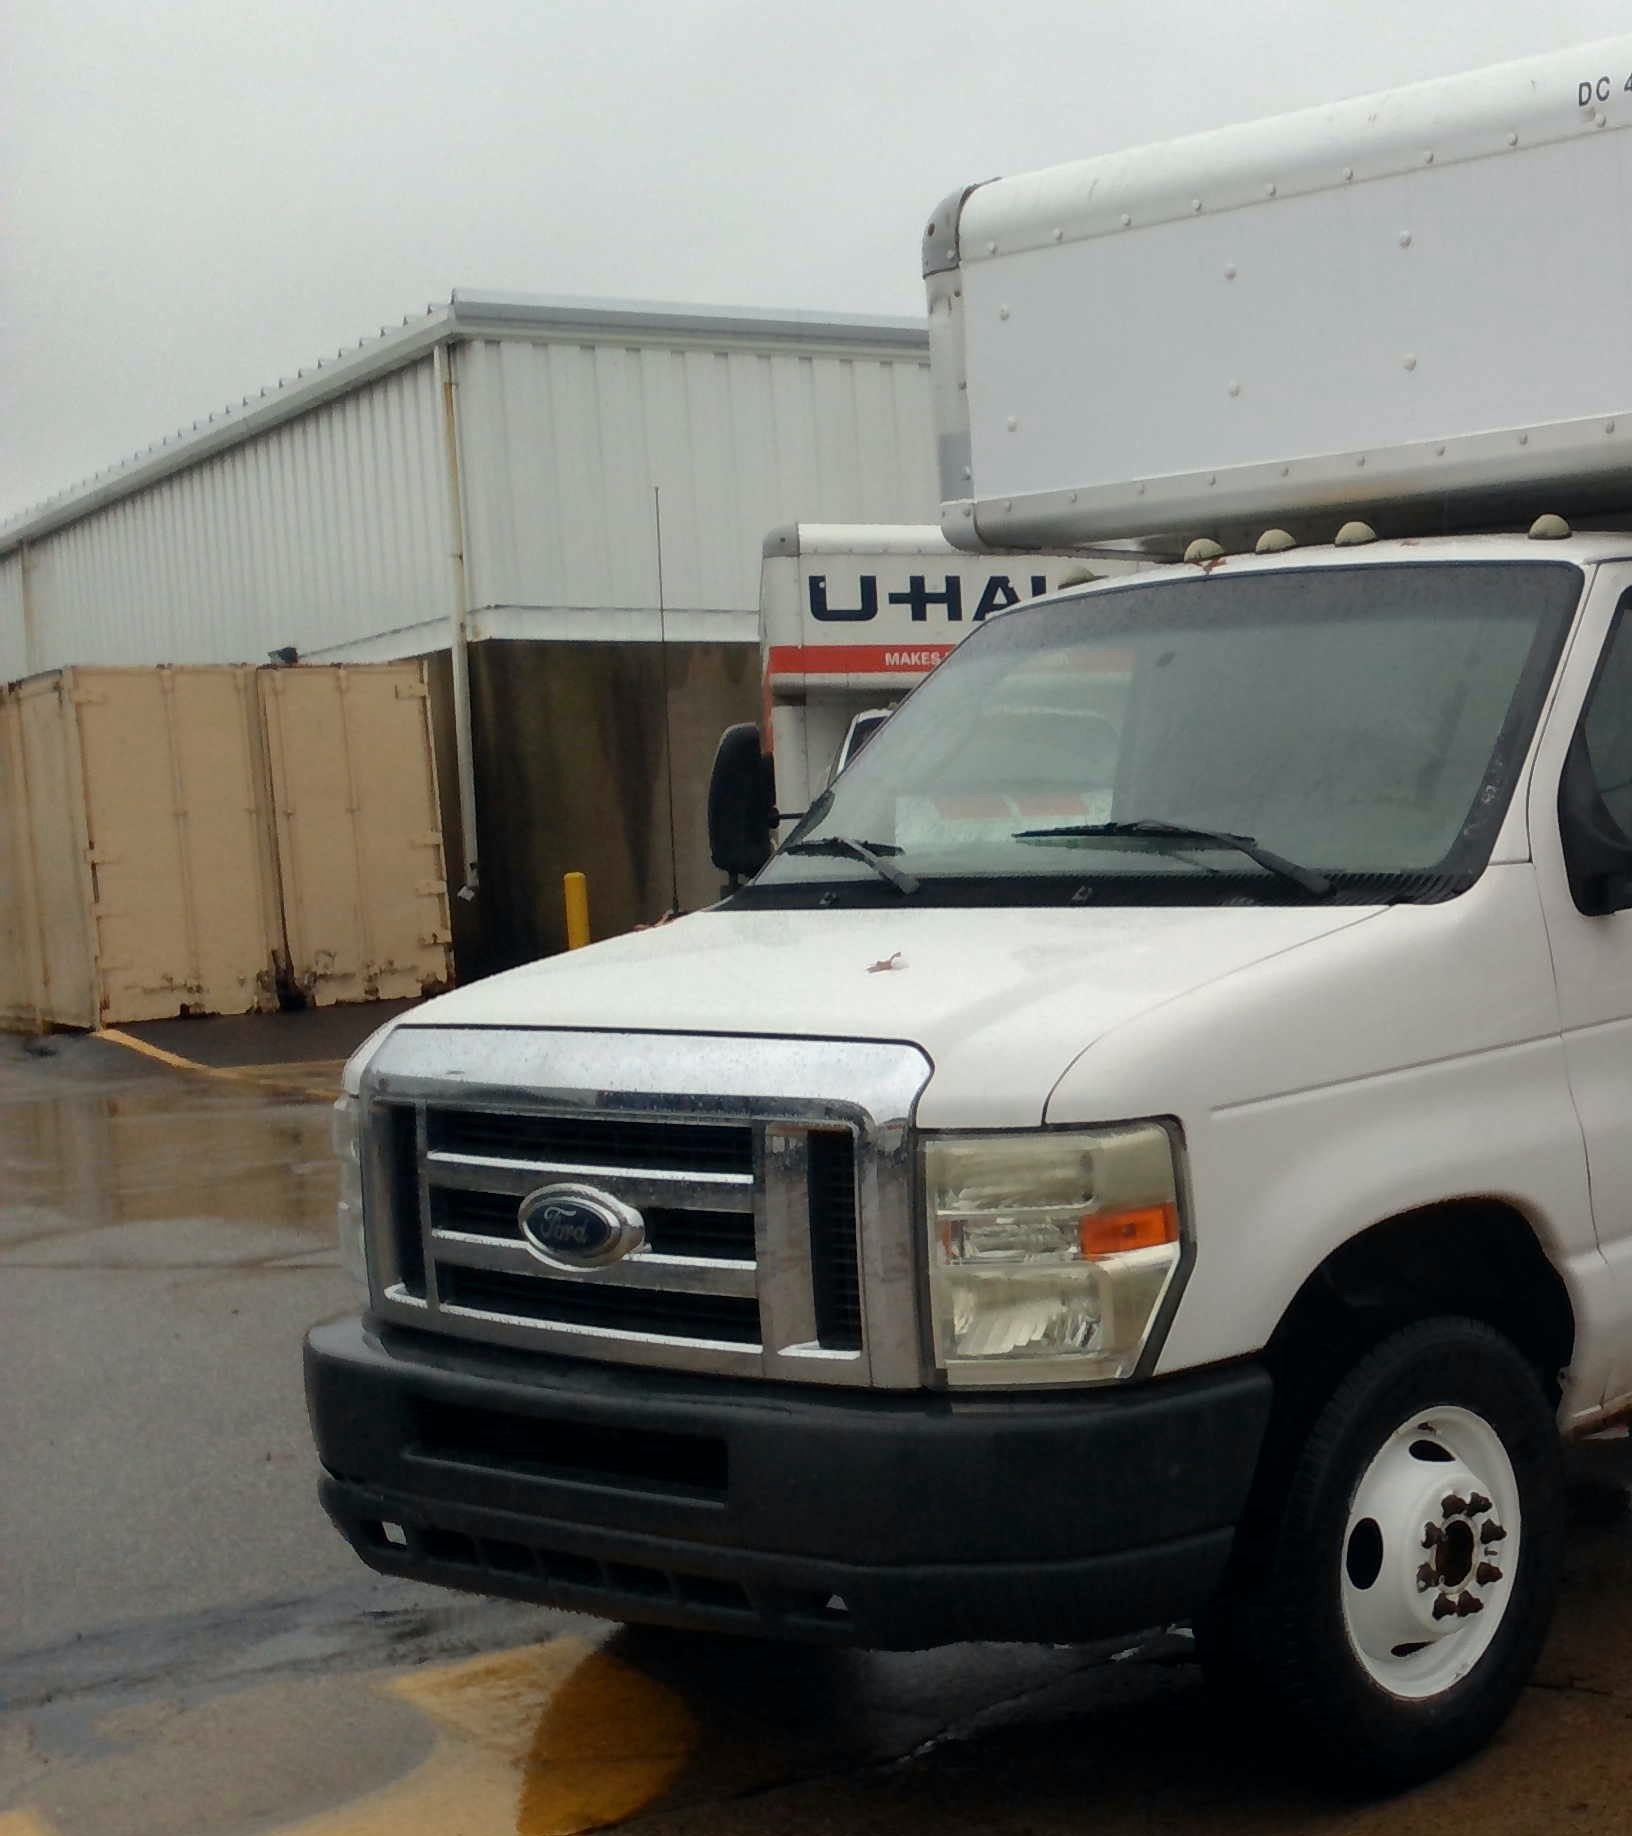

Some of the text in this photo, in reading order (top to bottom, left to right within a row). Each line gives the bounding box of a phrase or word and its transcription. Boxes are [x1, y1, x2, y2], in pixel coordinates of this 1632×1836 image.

[1578, 75, 1611, 106] DC
[808, 575, 1046, 622] U-HA
[884, 651, 942, 666] MAKES
